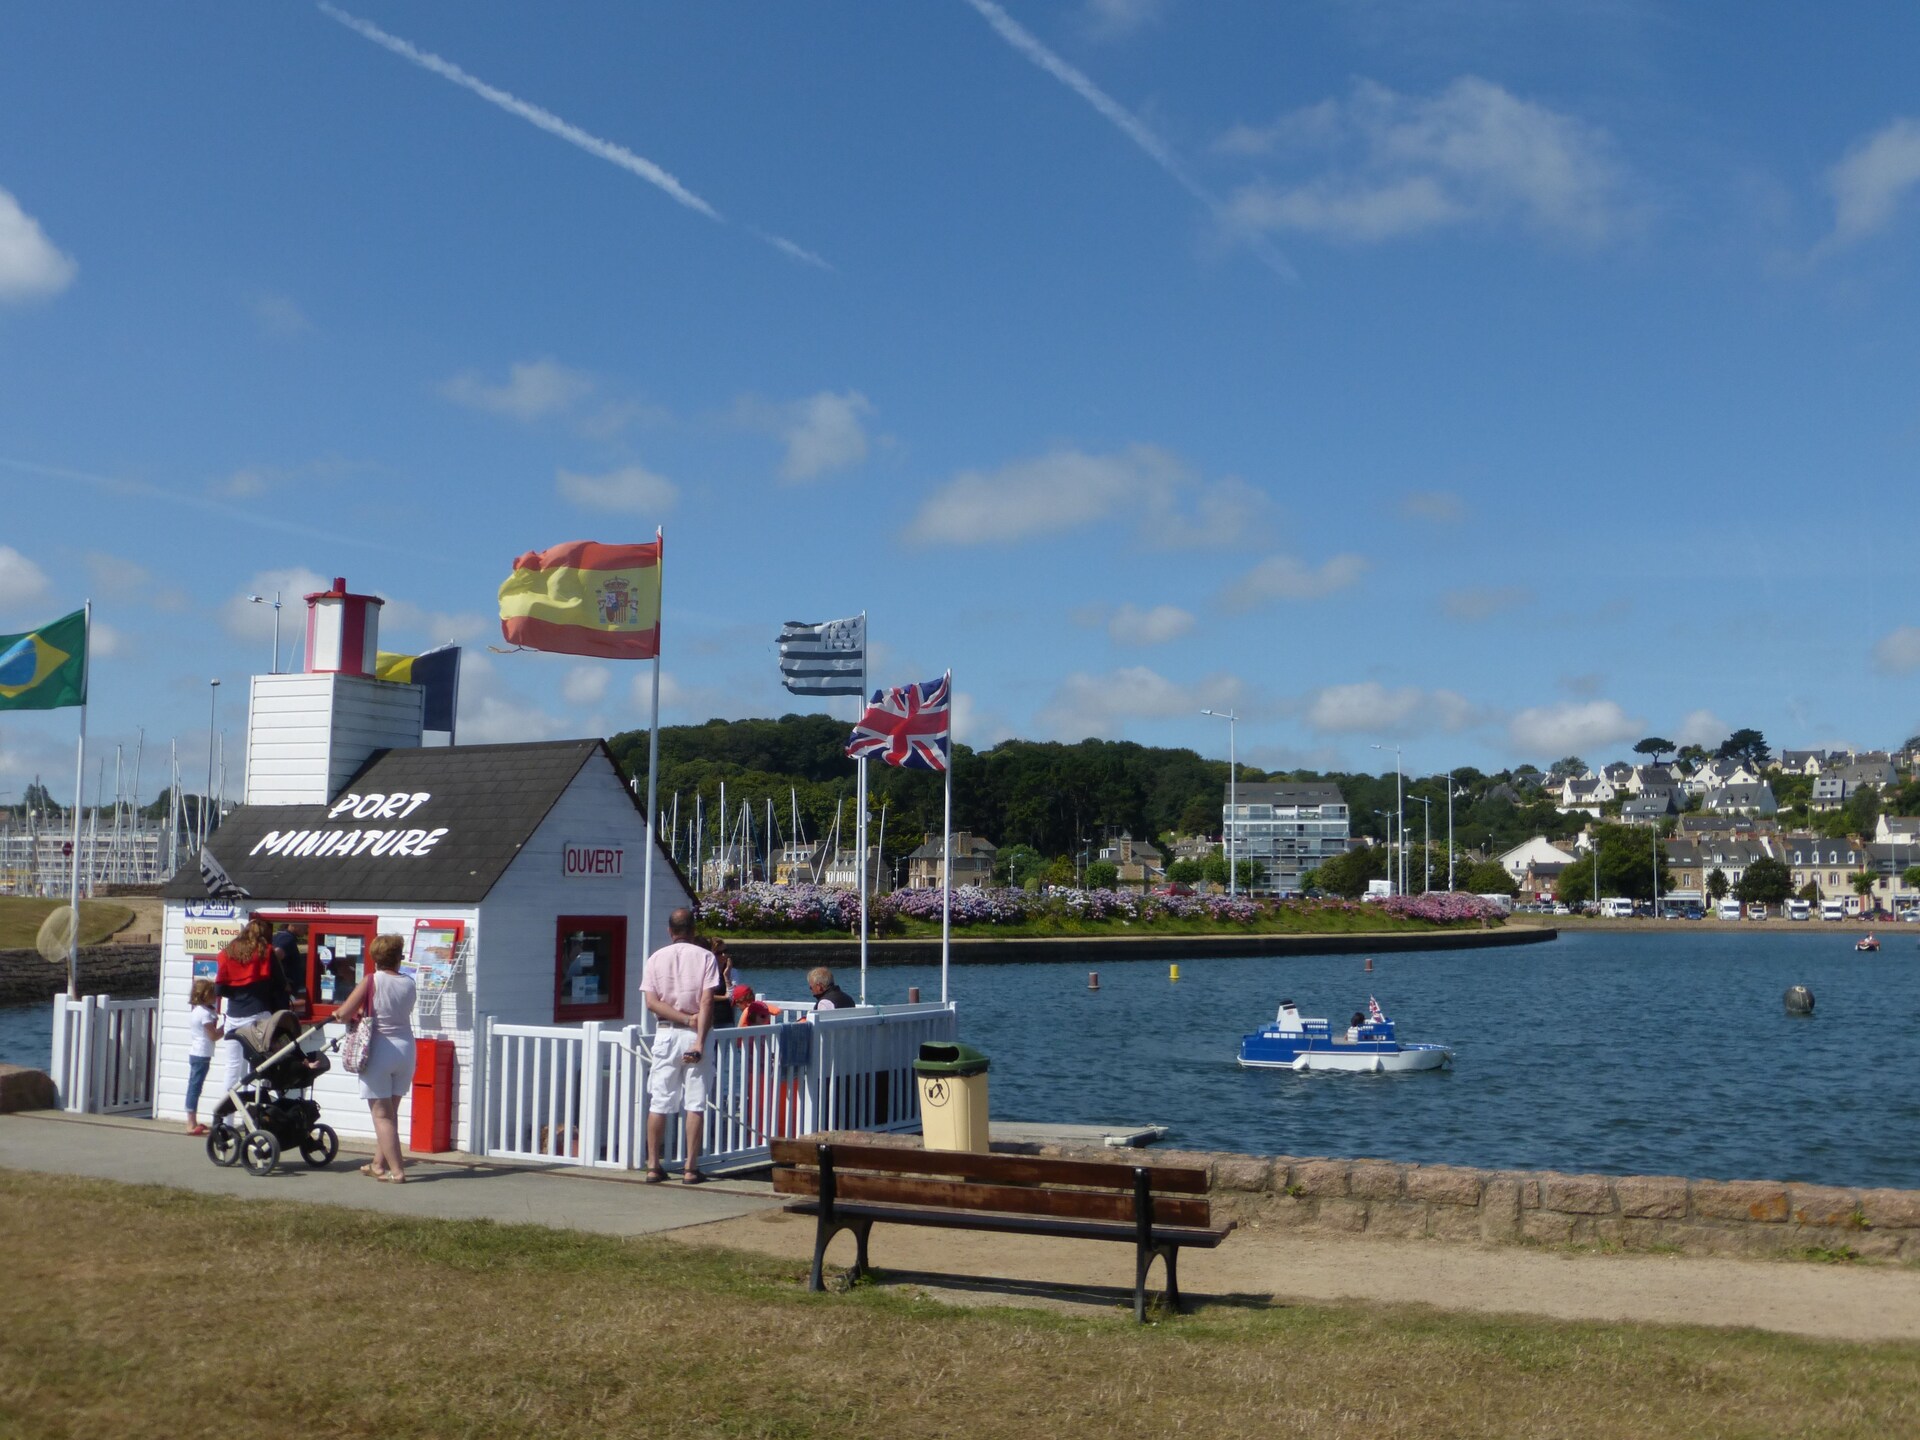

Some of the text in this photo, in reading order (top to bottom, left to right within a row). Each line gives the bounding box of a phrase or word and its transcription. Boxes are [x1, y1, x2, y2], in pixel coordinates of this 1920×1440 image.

[328, 792, 431, 819] PORT
[249, 827, 449, 857] MINIATURE
[567, 848, 624, 874] OUVERT
[204, 899, 228, 910] PORT
[288, 901, 327, 912] BILLETTERIE
[184, 926, 240, 936] OUVERT A tous
[185, 939, 208, 950] 10H00
